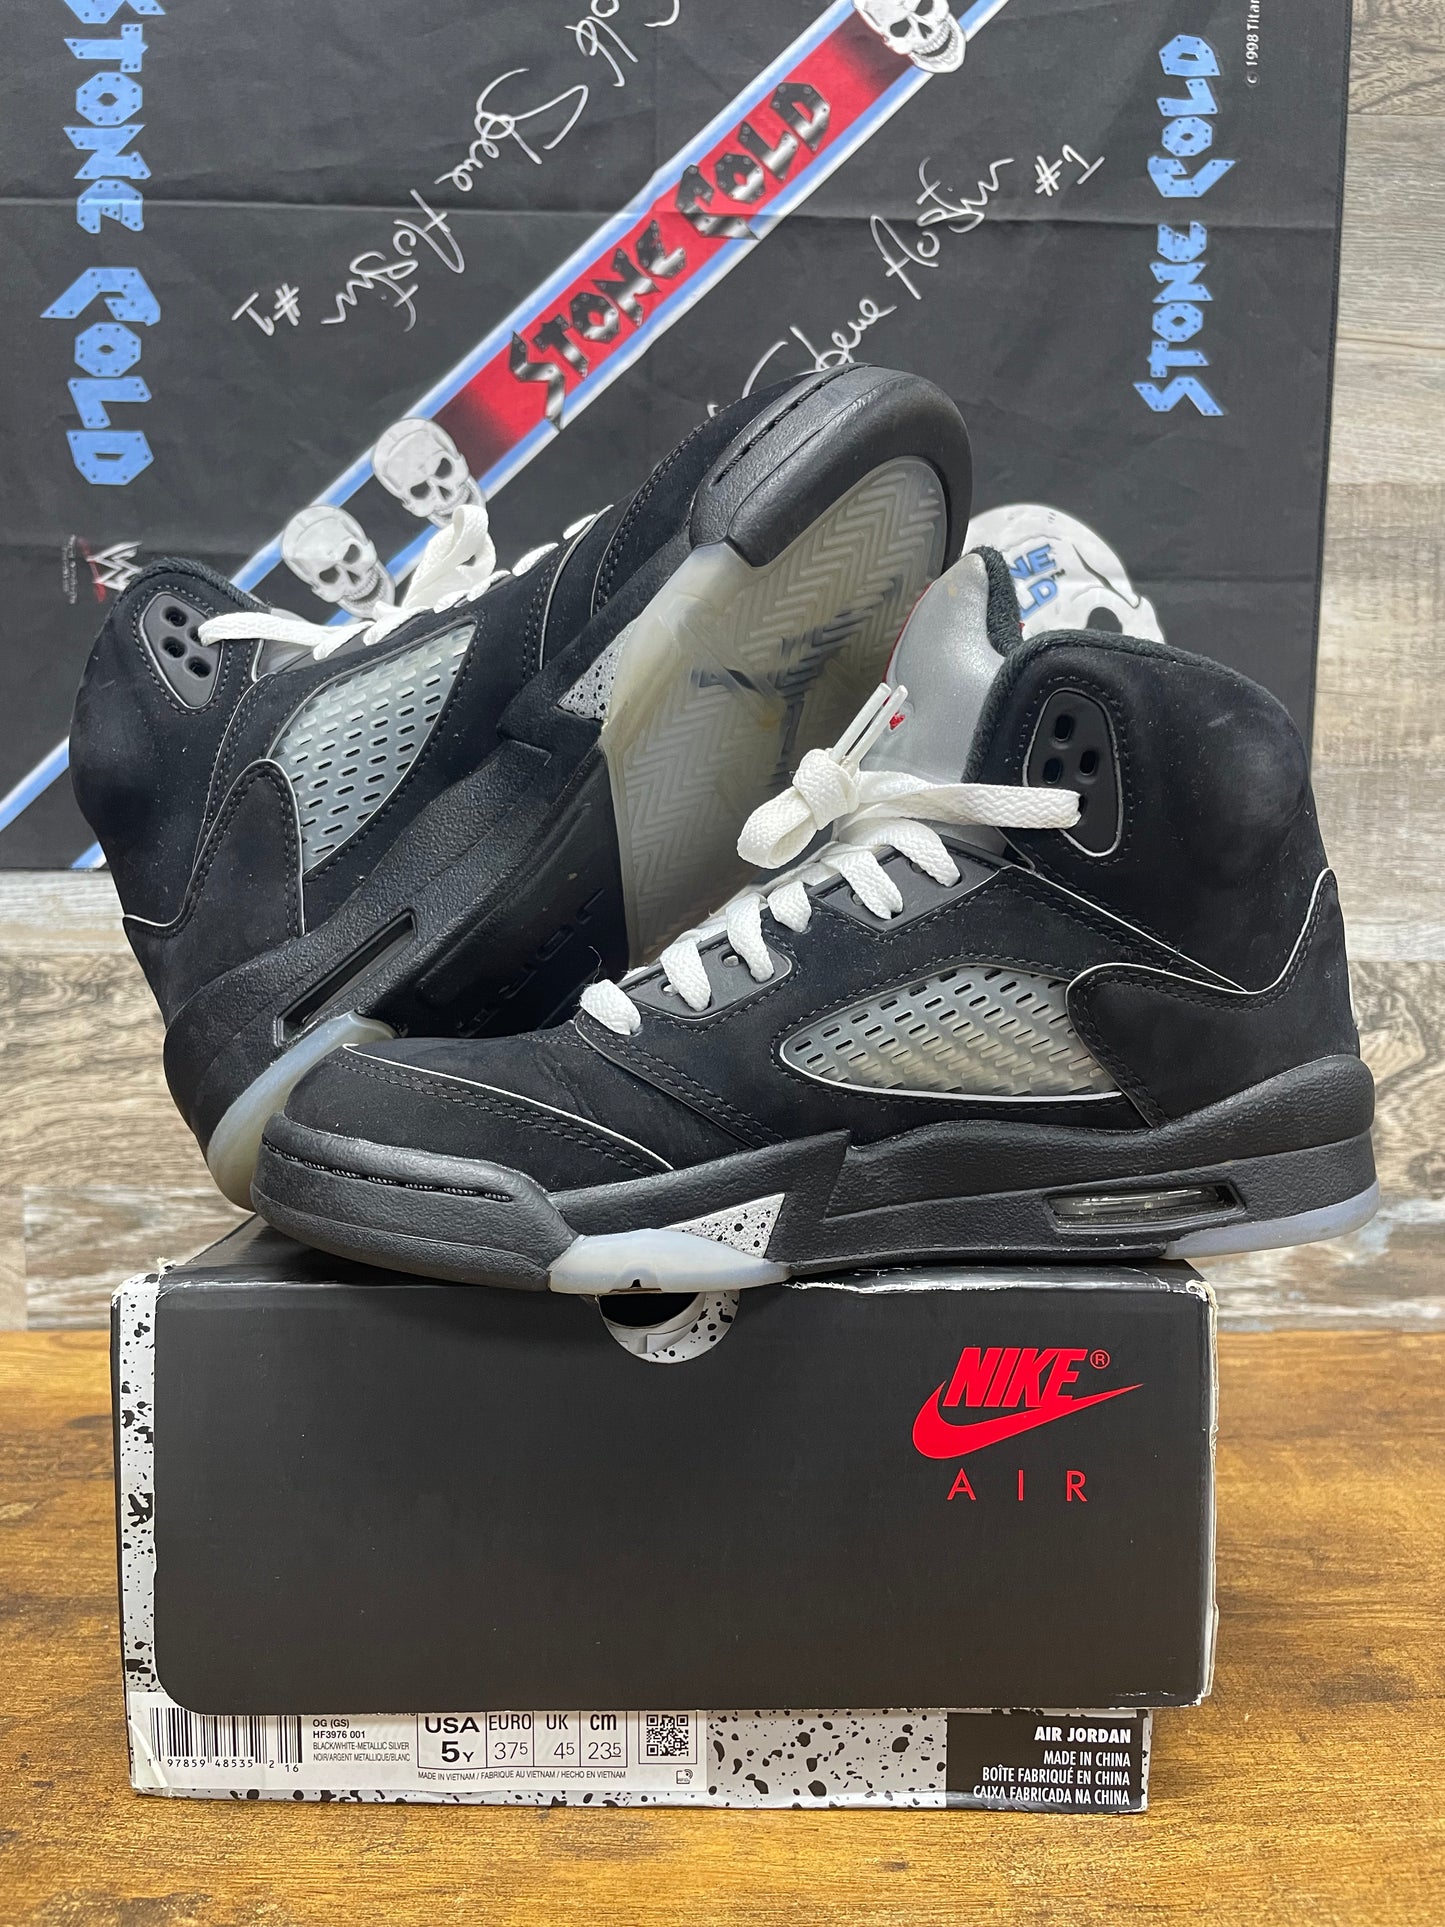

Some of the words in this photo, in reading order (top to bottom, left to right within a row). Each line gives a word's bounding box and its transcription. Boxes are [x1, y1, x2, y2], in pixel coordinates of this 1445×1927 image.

[1246, 34, 1259, 66] 1998
[1148, 34, 1235, 198] COLD
[1033, 144, 1105, 198] #1
[508, 219, 687, 431] STONE
[675, 82, 831, 241] COLD
[231, 283, 300, 336] #1
[1133, 221, 1224, 416] STONE
[40, 267, 161, 485] COLD
[313, 1719, 327, 1728] OG
[330, 1718, 350, 1729] (GS)
[425, 1716, 480, 1734] USA
[489, 1714, 532, 1731] EURO
[546, 1714, 569, 1730] UK
[590, 1713, 617, 1731] cm
[313, 1730, 347, 1739] HF3976
[350, 1730, 366, 1739] 001
[1034, 1726, 1062, 1742] AIR
[1067, 1727, 1131, 1744] JORDAN
[313, 1741, 387, 1751] BLACK/WHITE-METALLIC
[388, 1741, 410, 1751] SILVER
[167, 1759, 206, 1768] 97859
[215, 1760, 253, 1768] 48535
[268, 1760, 275, 1769] 2
[1043, 1750, 1076, 1766] MADE
[1079, 1751, 1092, 1766] IN
[1095, 1752, 1131, 1768] CHINA
[285, 1765, 299, 1773] 16
[418, 1771, 436, 1780] MADE
[438, 1772, 445, 1781] IN
[446, 1773, 475, 1781] VIETNAM
[516, 1770, 525, 1778] AU
[526, 1770, 555, 1778] VIETNAM
[561, 1770, 585, 1778] HECHO
[587, 1770, 596, 1778] EN
[597, 1770, 626, 1778] VIETNAM
[982, 1764, 1015, 1782] BOÎTE
[1017, 1767, 1074, 1785] FABRIQUÉ
[1077, 1770, 1092, 1785] EN
[1095, 1770, 1131, 1786] CHINA
[973, 1784, 1007, 1800] CAIXA
[1009, 1786, 1072, 1803] FABRICADA
[1075, 1788, 1092, 1805] NA
[1095, 1789, 1131, 1806] CHINA
